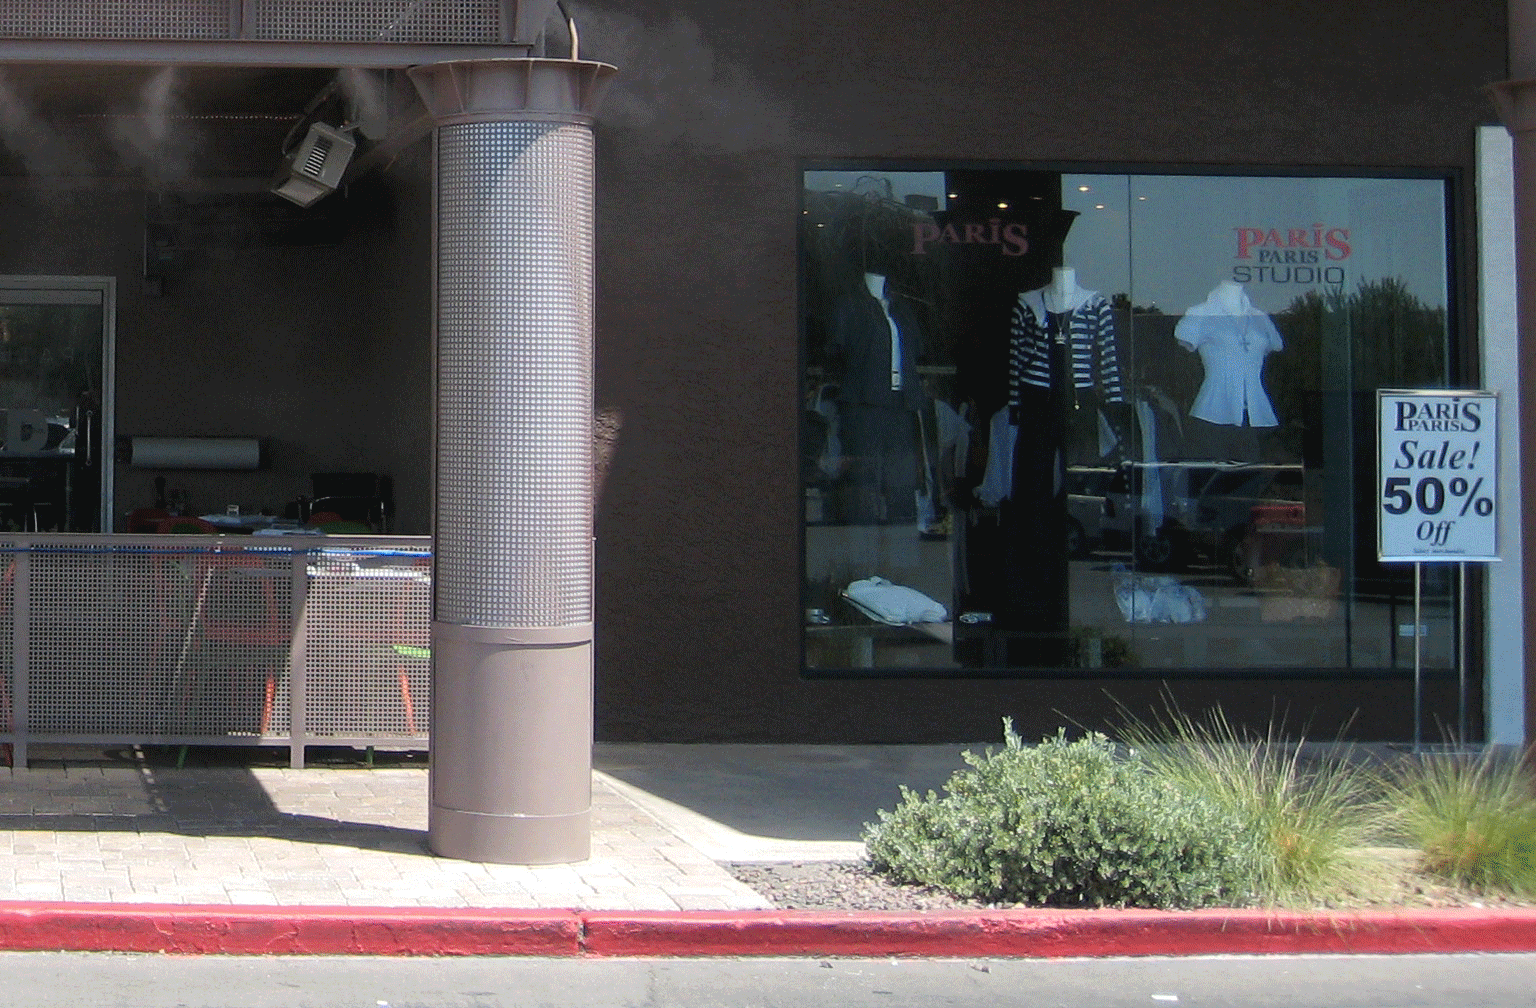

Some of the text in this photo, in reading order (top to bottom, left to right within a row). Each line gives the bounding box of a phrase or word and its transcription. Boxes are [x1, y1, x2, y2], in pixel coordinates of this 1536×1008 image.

[1233, 223, 1352, 260] PARIS
[1259, 249, 1319, 263] PARIS
[1233, 265, 1345, 284] STUDIO
[1394, 396, 1481, 432] PARIS
[1408, 420, 1460, 432] PARIS
[1394, 440, 1480, 470] Sale!
[1383, 477, 1493, 517] 50%
[1416, 520, 1456, 546] Off
